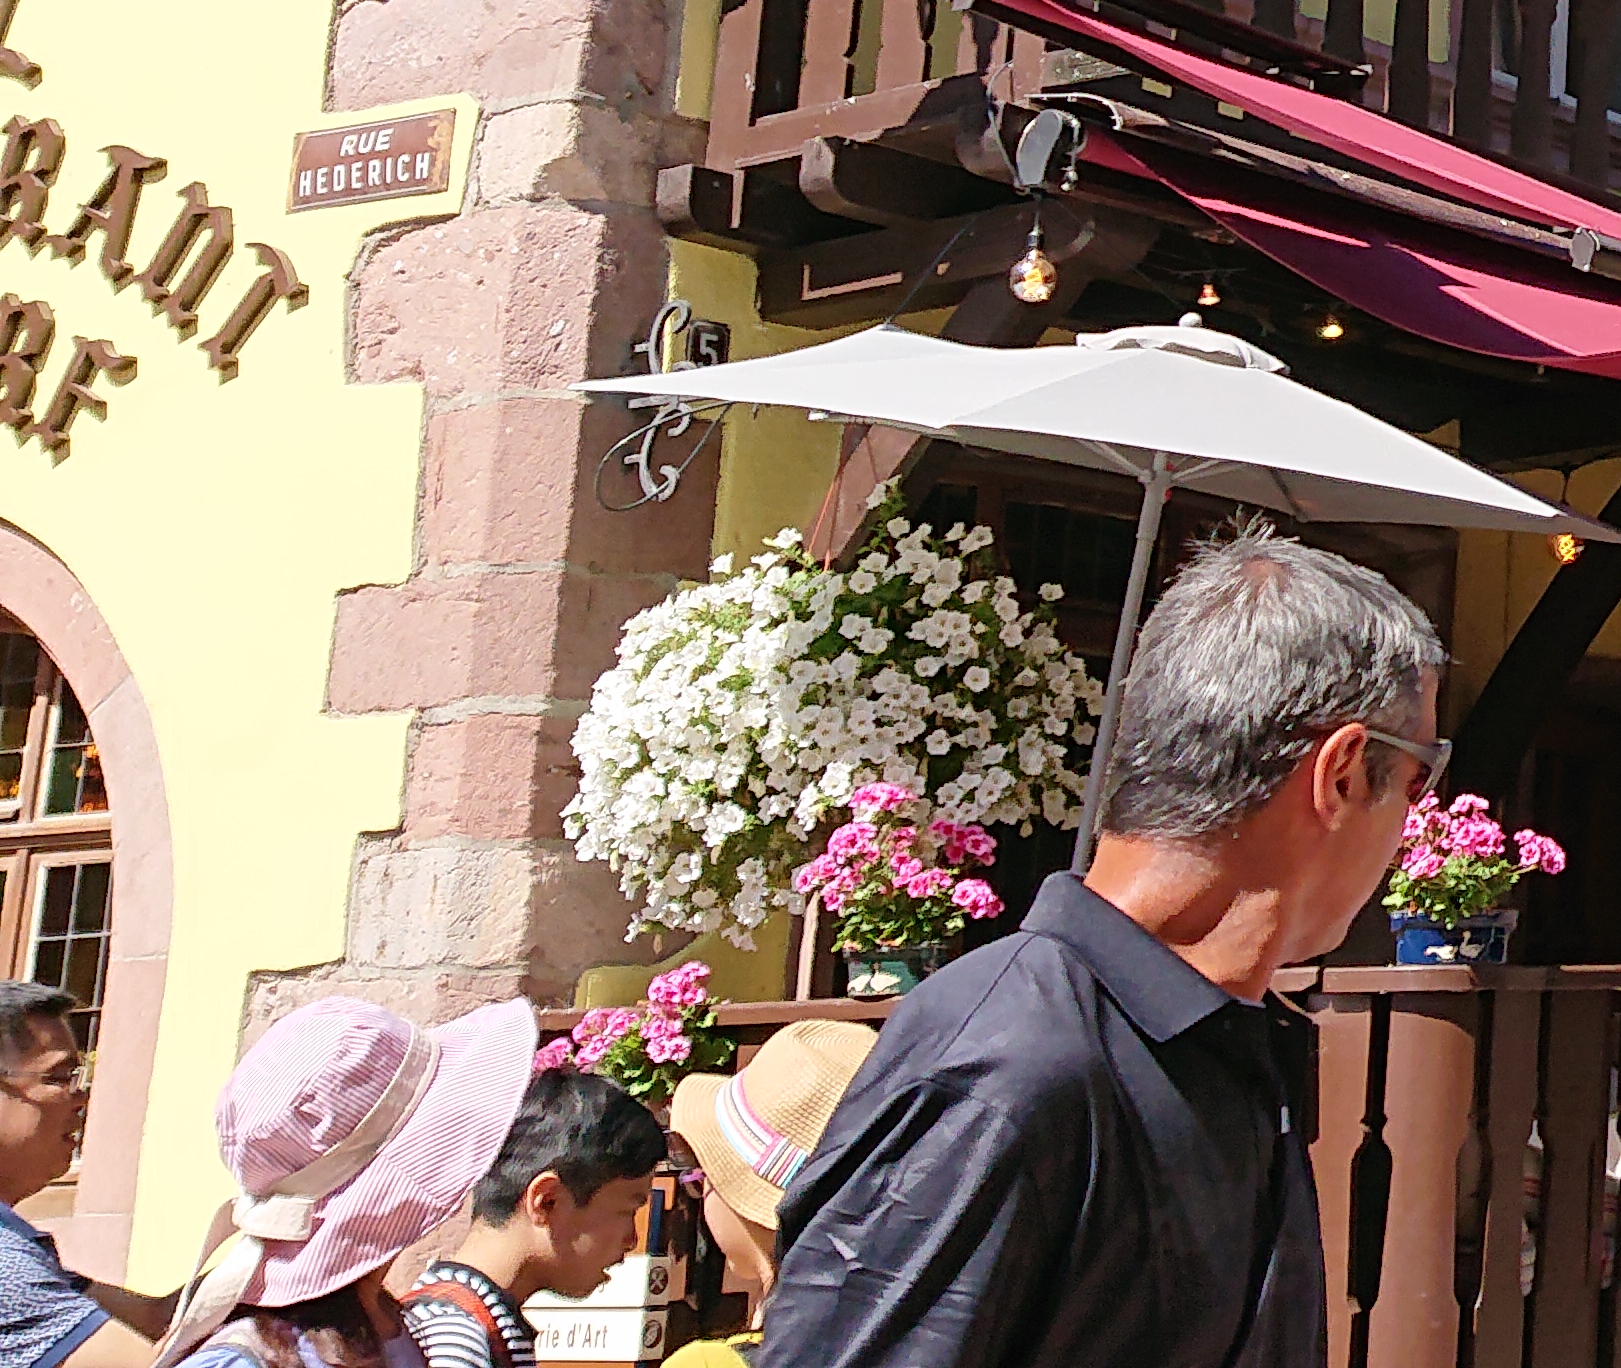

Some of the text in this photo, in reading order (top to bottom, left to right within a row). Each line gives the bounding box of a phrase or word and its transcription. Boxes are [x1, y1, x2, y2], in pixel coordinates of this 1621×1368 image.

[339, 128, 395, 157] RUE
[298, 151, 431, 198] HEDERICH
[0, 115, 310, 386] RANT
[0, 292, 138, 469] RF
[538, 1323, 608, 1349] rie d'Art
